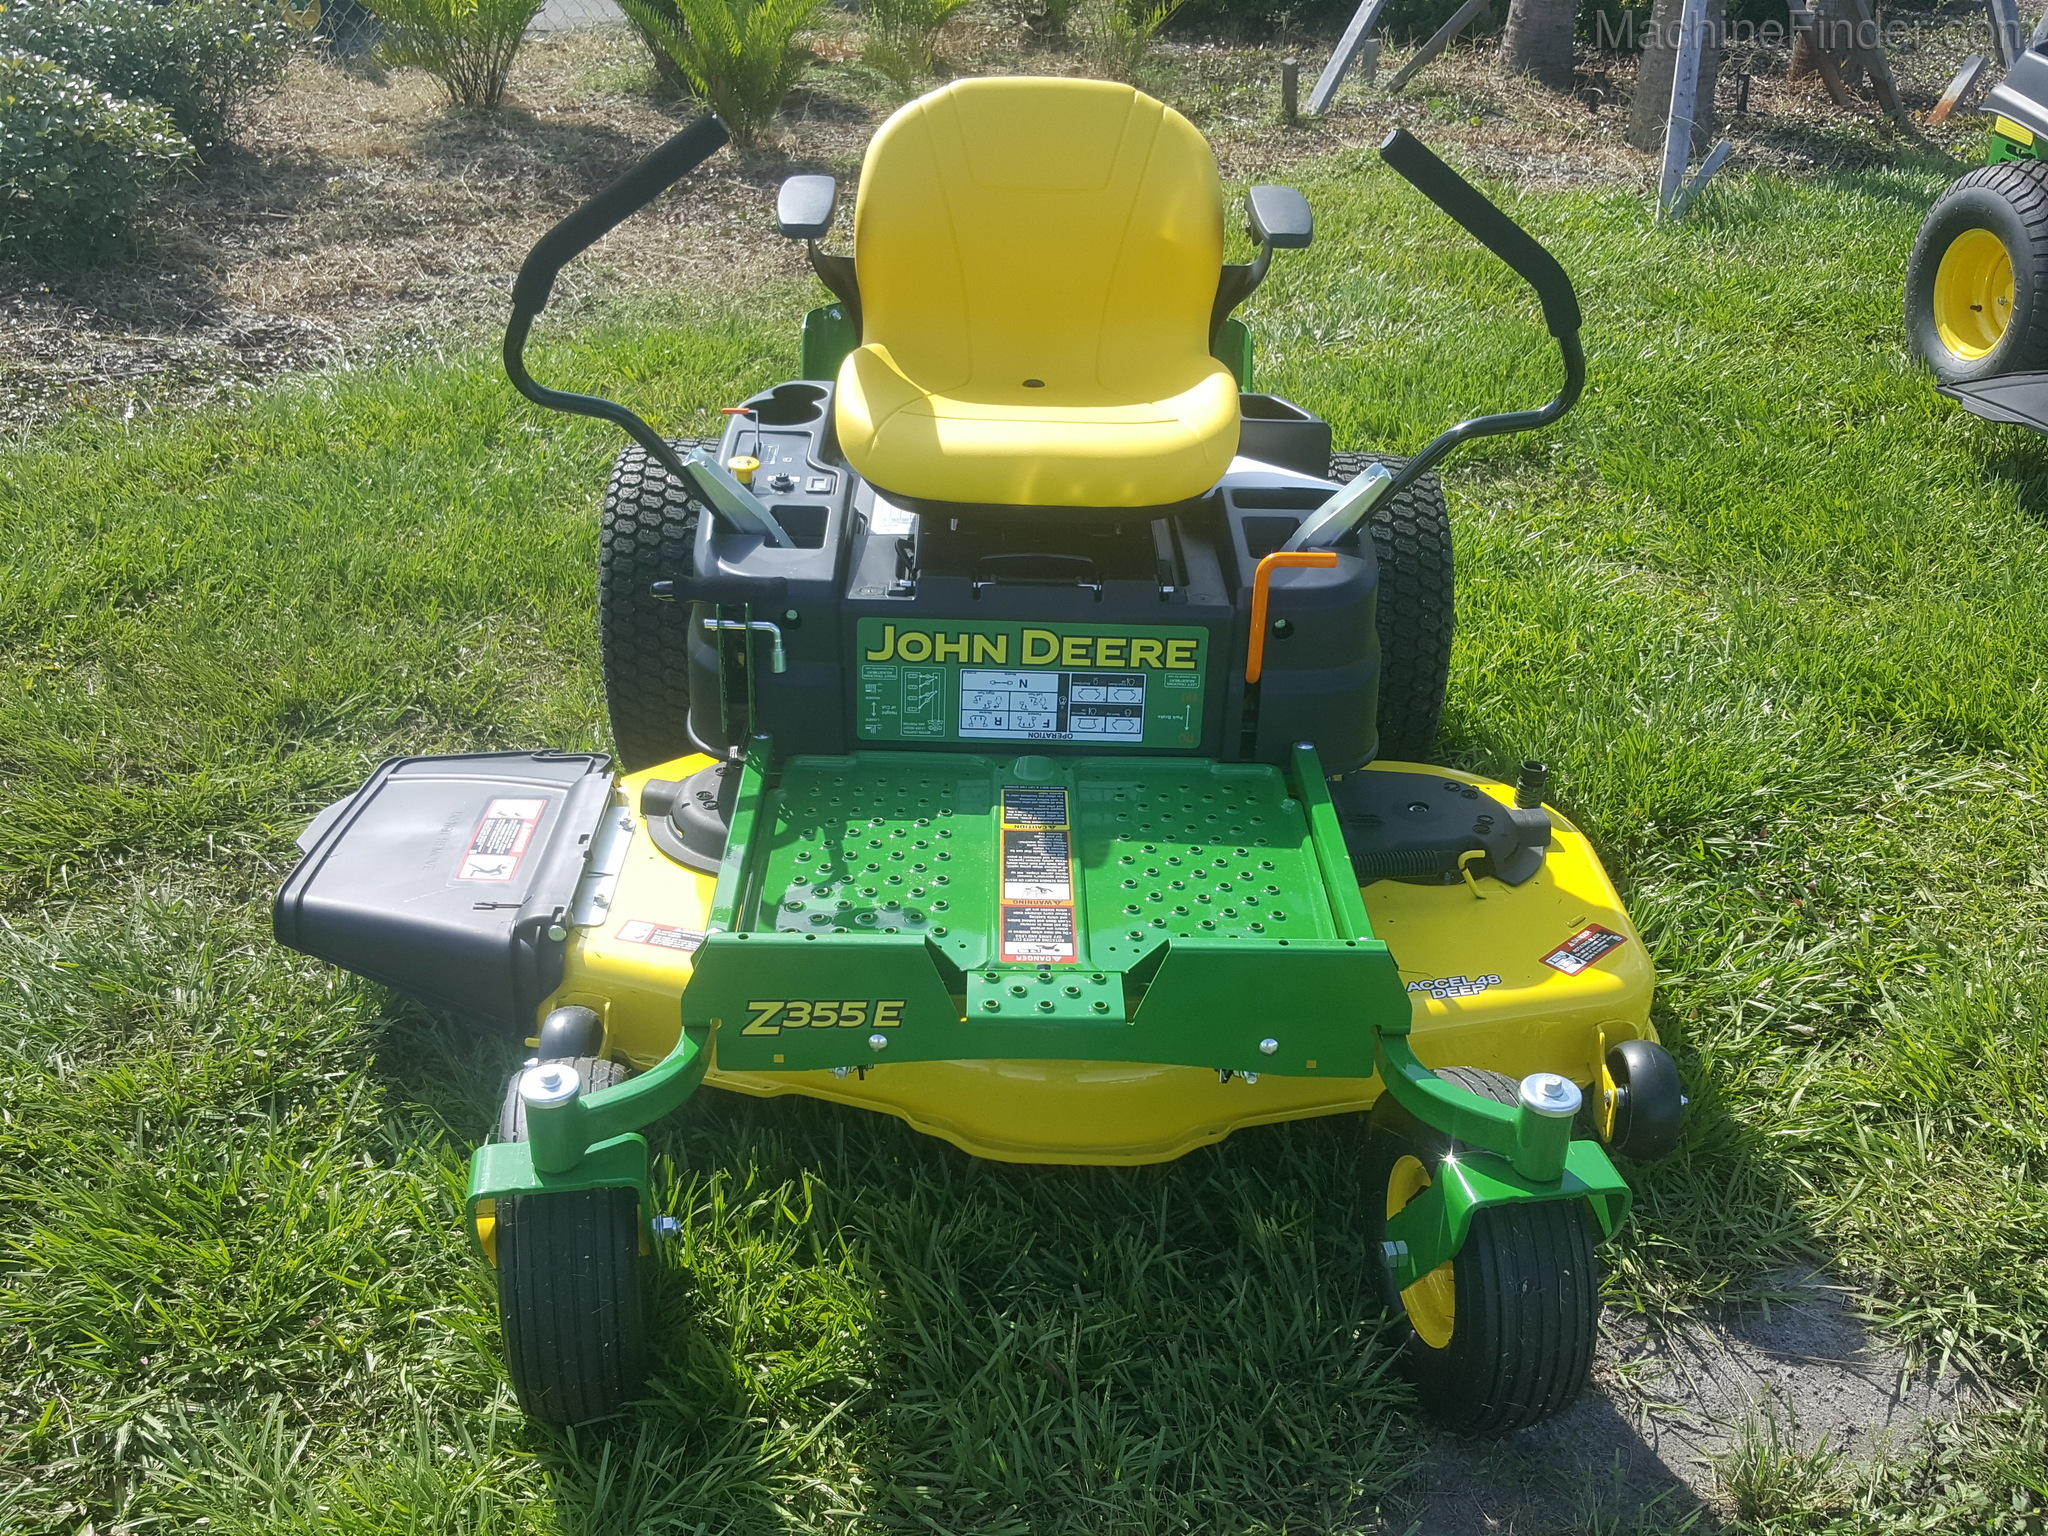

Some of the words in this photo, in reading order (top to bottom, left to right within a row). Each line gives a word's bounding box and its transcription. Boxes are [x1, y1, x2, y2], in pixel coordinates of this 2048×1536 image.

[866, 624, 1009, 665] JOHN
[1020, 628, 1199, 670] DEERE
[1019, 679, 1028, 688] N
[994, 717, 1002, 726] R
[1042, 719, 1050, 728] F
[1028, 731, 1074, 740] OPERATION
[1430, 983, 1487, 999] DEEP
